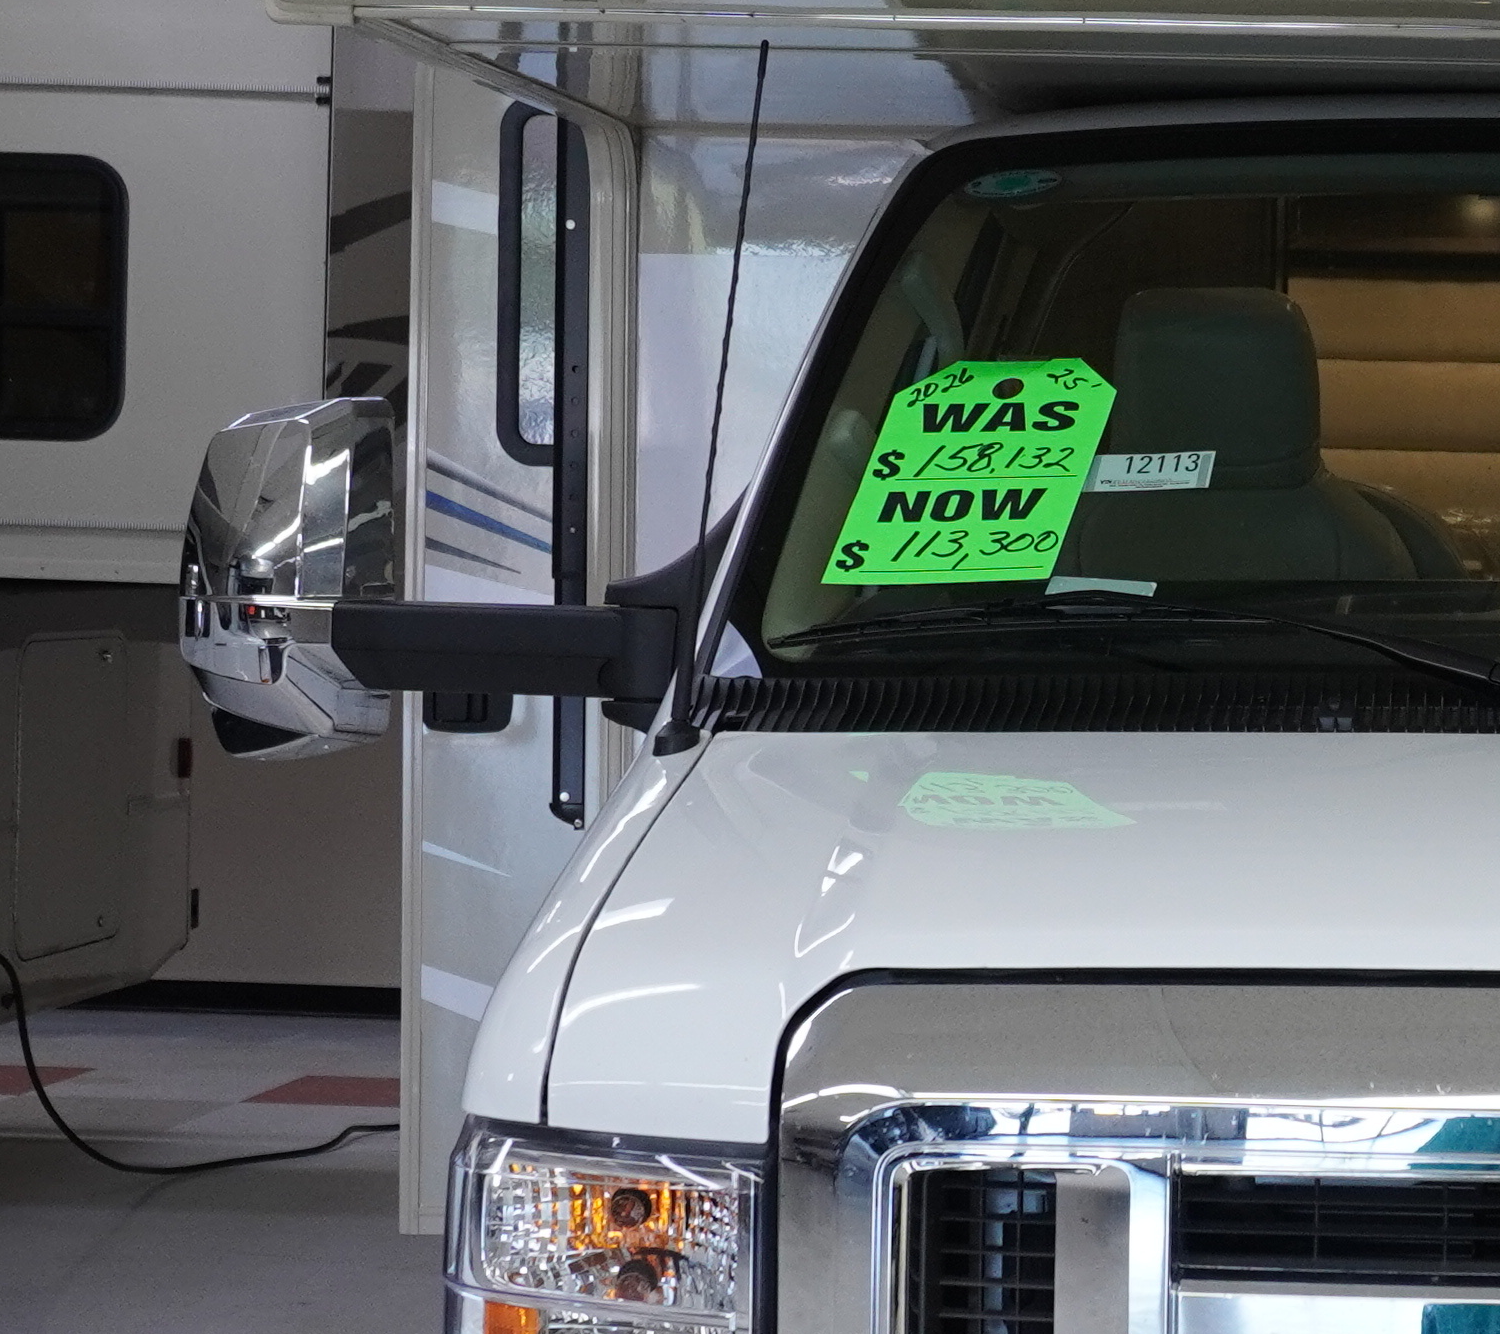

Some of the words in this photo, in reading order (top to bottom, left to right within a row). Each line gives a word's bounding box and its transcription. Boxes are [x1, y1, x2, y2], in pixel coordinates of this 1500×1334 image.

[907, 367, 975, 407] 2026
[922, 401, 1080, 433] WAS
[913, 442, 1074, 477] 158,132
[1125, 453, 1201, 474] 12113
[877, 488, 1048, 523] NOW
[890, 530, 1059, 570] 113,300
